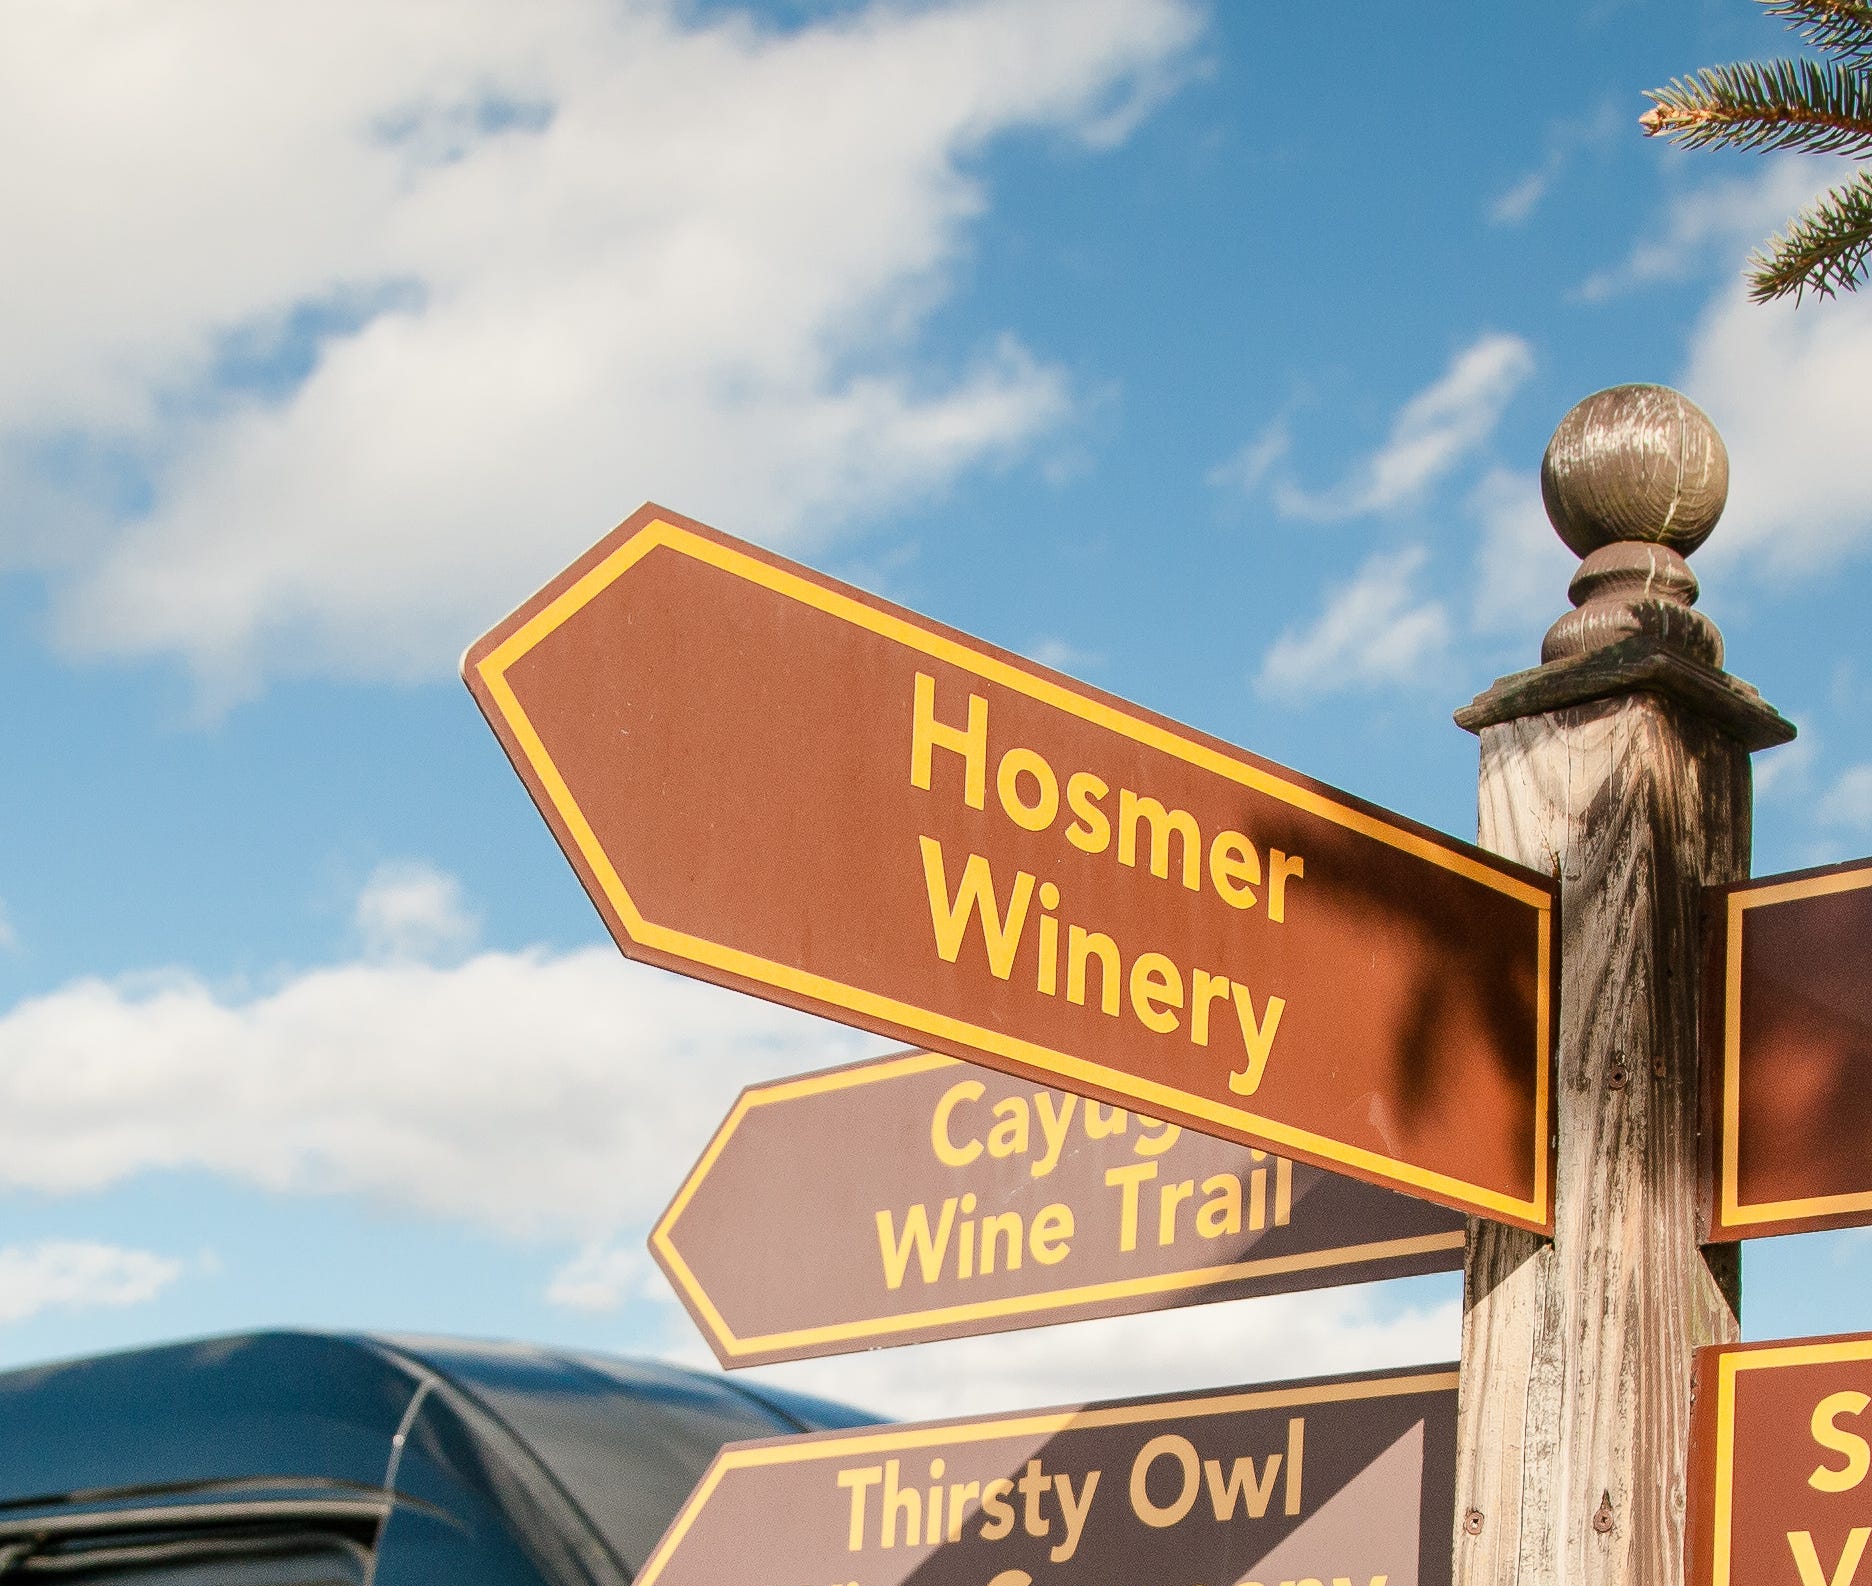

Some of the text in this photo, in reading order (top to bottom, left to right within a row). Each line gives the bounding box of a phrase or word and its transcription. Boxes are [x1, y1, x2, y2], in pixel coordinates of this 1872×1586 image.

[911, 672, 1303, 924] Hosmer
[919, 833, 1287, 1097] Winery
[930, 1079, 1182, 1179] Cayu
[875, 1148, 1293, 1290] Wine Trail
[837, 1418, 1304, 1562] Thirsty Owl
